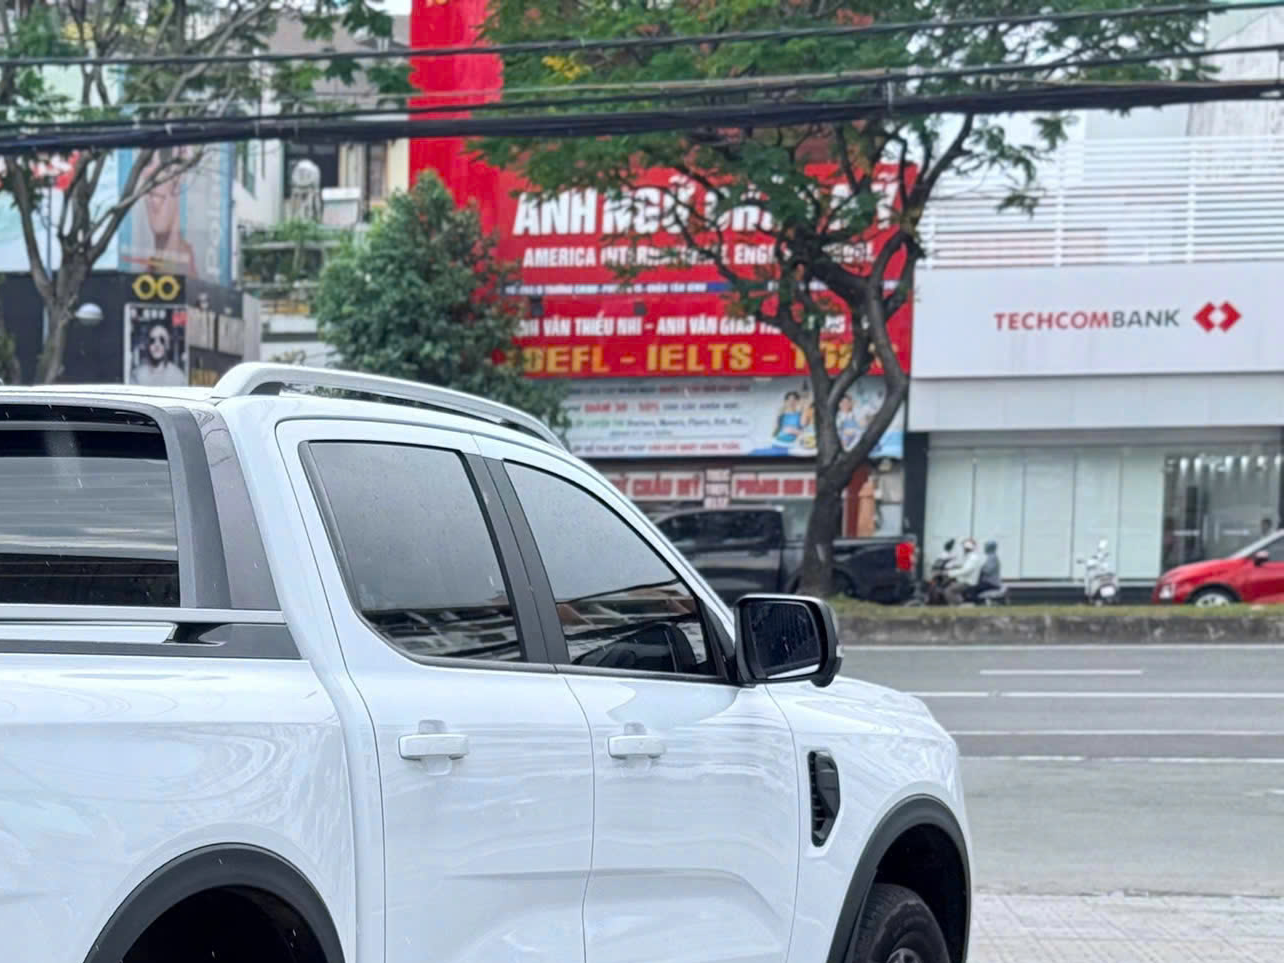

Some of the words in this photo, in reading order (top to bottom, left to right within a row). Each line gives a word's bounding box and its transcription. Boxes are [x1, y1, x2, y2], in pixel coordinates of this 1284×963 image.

[512, 187, 597, 235] ANH
[523, 248, 597, 267] AMERICA
[993, 309, 1180, 331] TECHCOMBANK
[646, 343, 753, 372] IELTS
